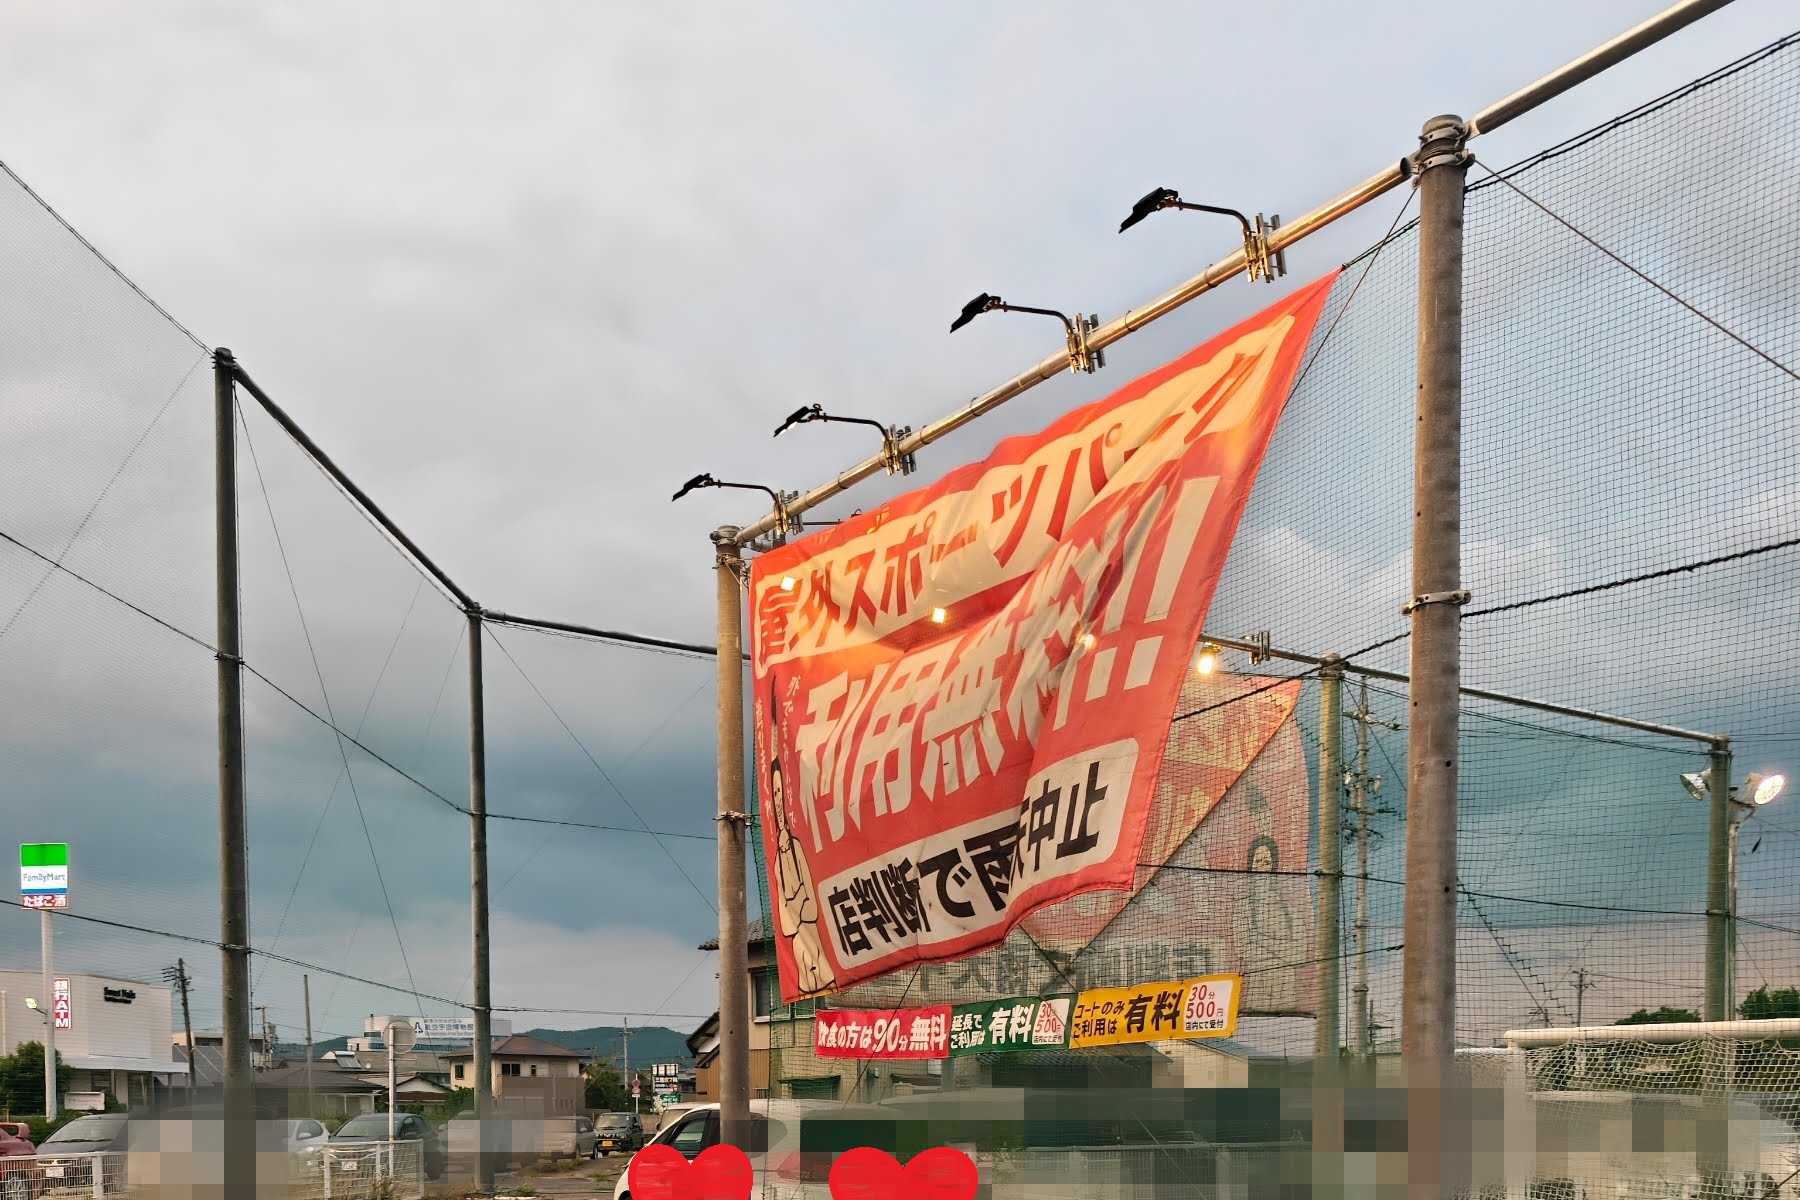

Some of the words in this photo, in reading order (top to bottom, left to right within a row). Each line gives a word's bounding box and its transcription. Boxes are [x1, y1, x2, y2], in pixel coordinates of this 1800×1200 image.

[757, 346, 1267, 666] 屋外スポーツパーク
[23, 873, 65, 882] FamilyMart
[1189, 984, 1215, 1002] 30分
[1075, 1000, 1125, 1019] コートのみ
[1125, 988, 1184, 1034] 有料
[1186, 1001, 1223, 1019] 500円
[951, 1013, 982, 1031] 延長で
[989, 1003, 1034, 1045] 有料
[1073, 1018, 1118, 1039] ご利用は
